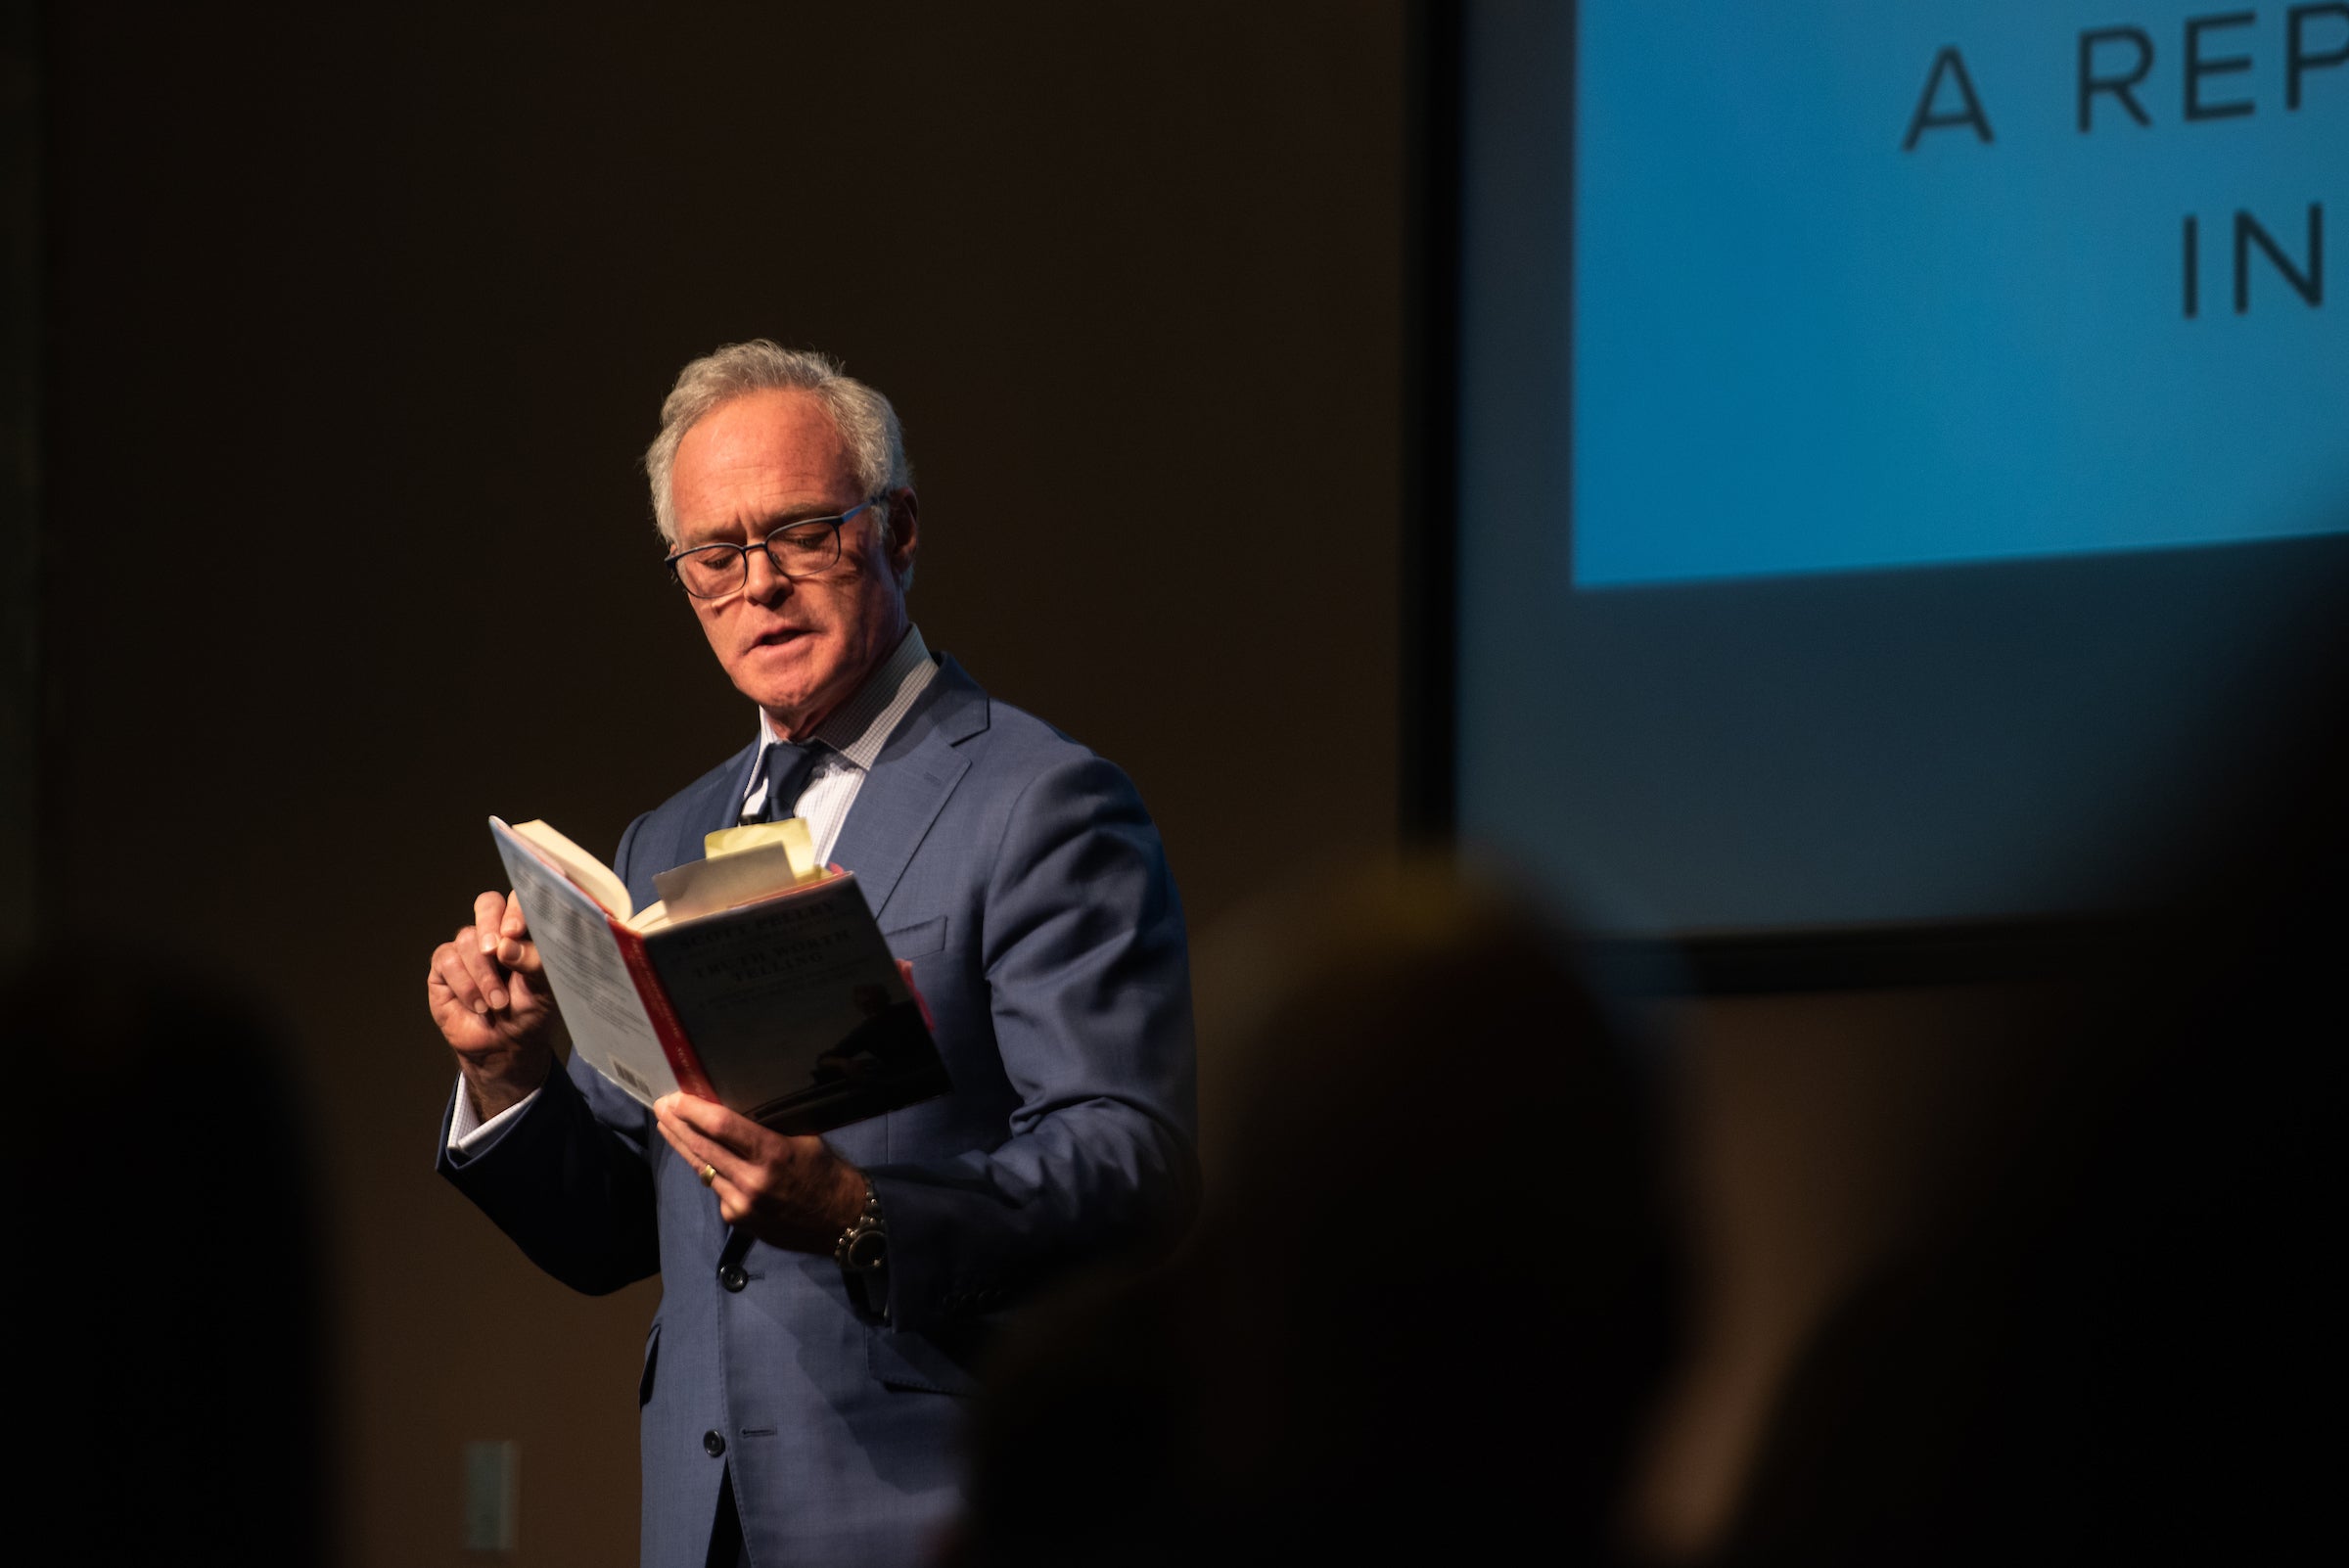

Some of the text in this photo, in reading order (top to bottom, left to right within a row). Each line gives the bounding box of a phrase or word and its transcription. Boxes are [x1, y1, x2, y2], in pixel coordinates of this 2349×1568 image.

[1902, 2, 2349, 153] A REP
[2183, 202, 2325, 320] IN
[694, 952, 768, 979] TRUTH
[773, 929, 852, 956] WORTH
[733, 951, 823, 982] TELLING
